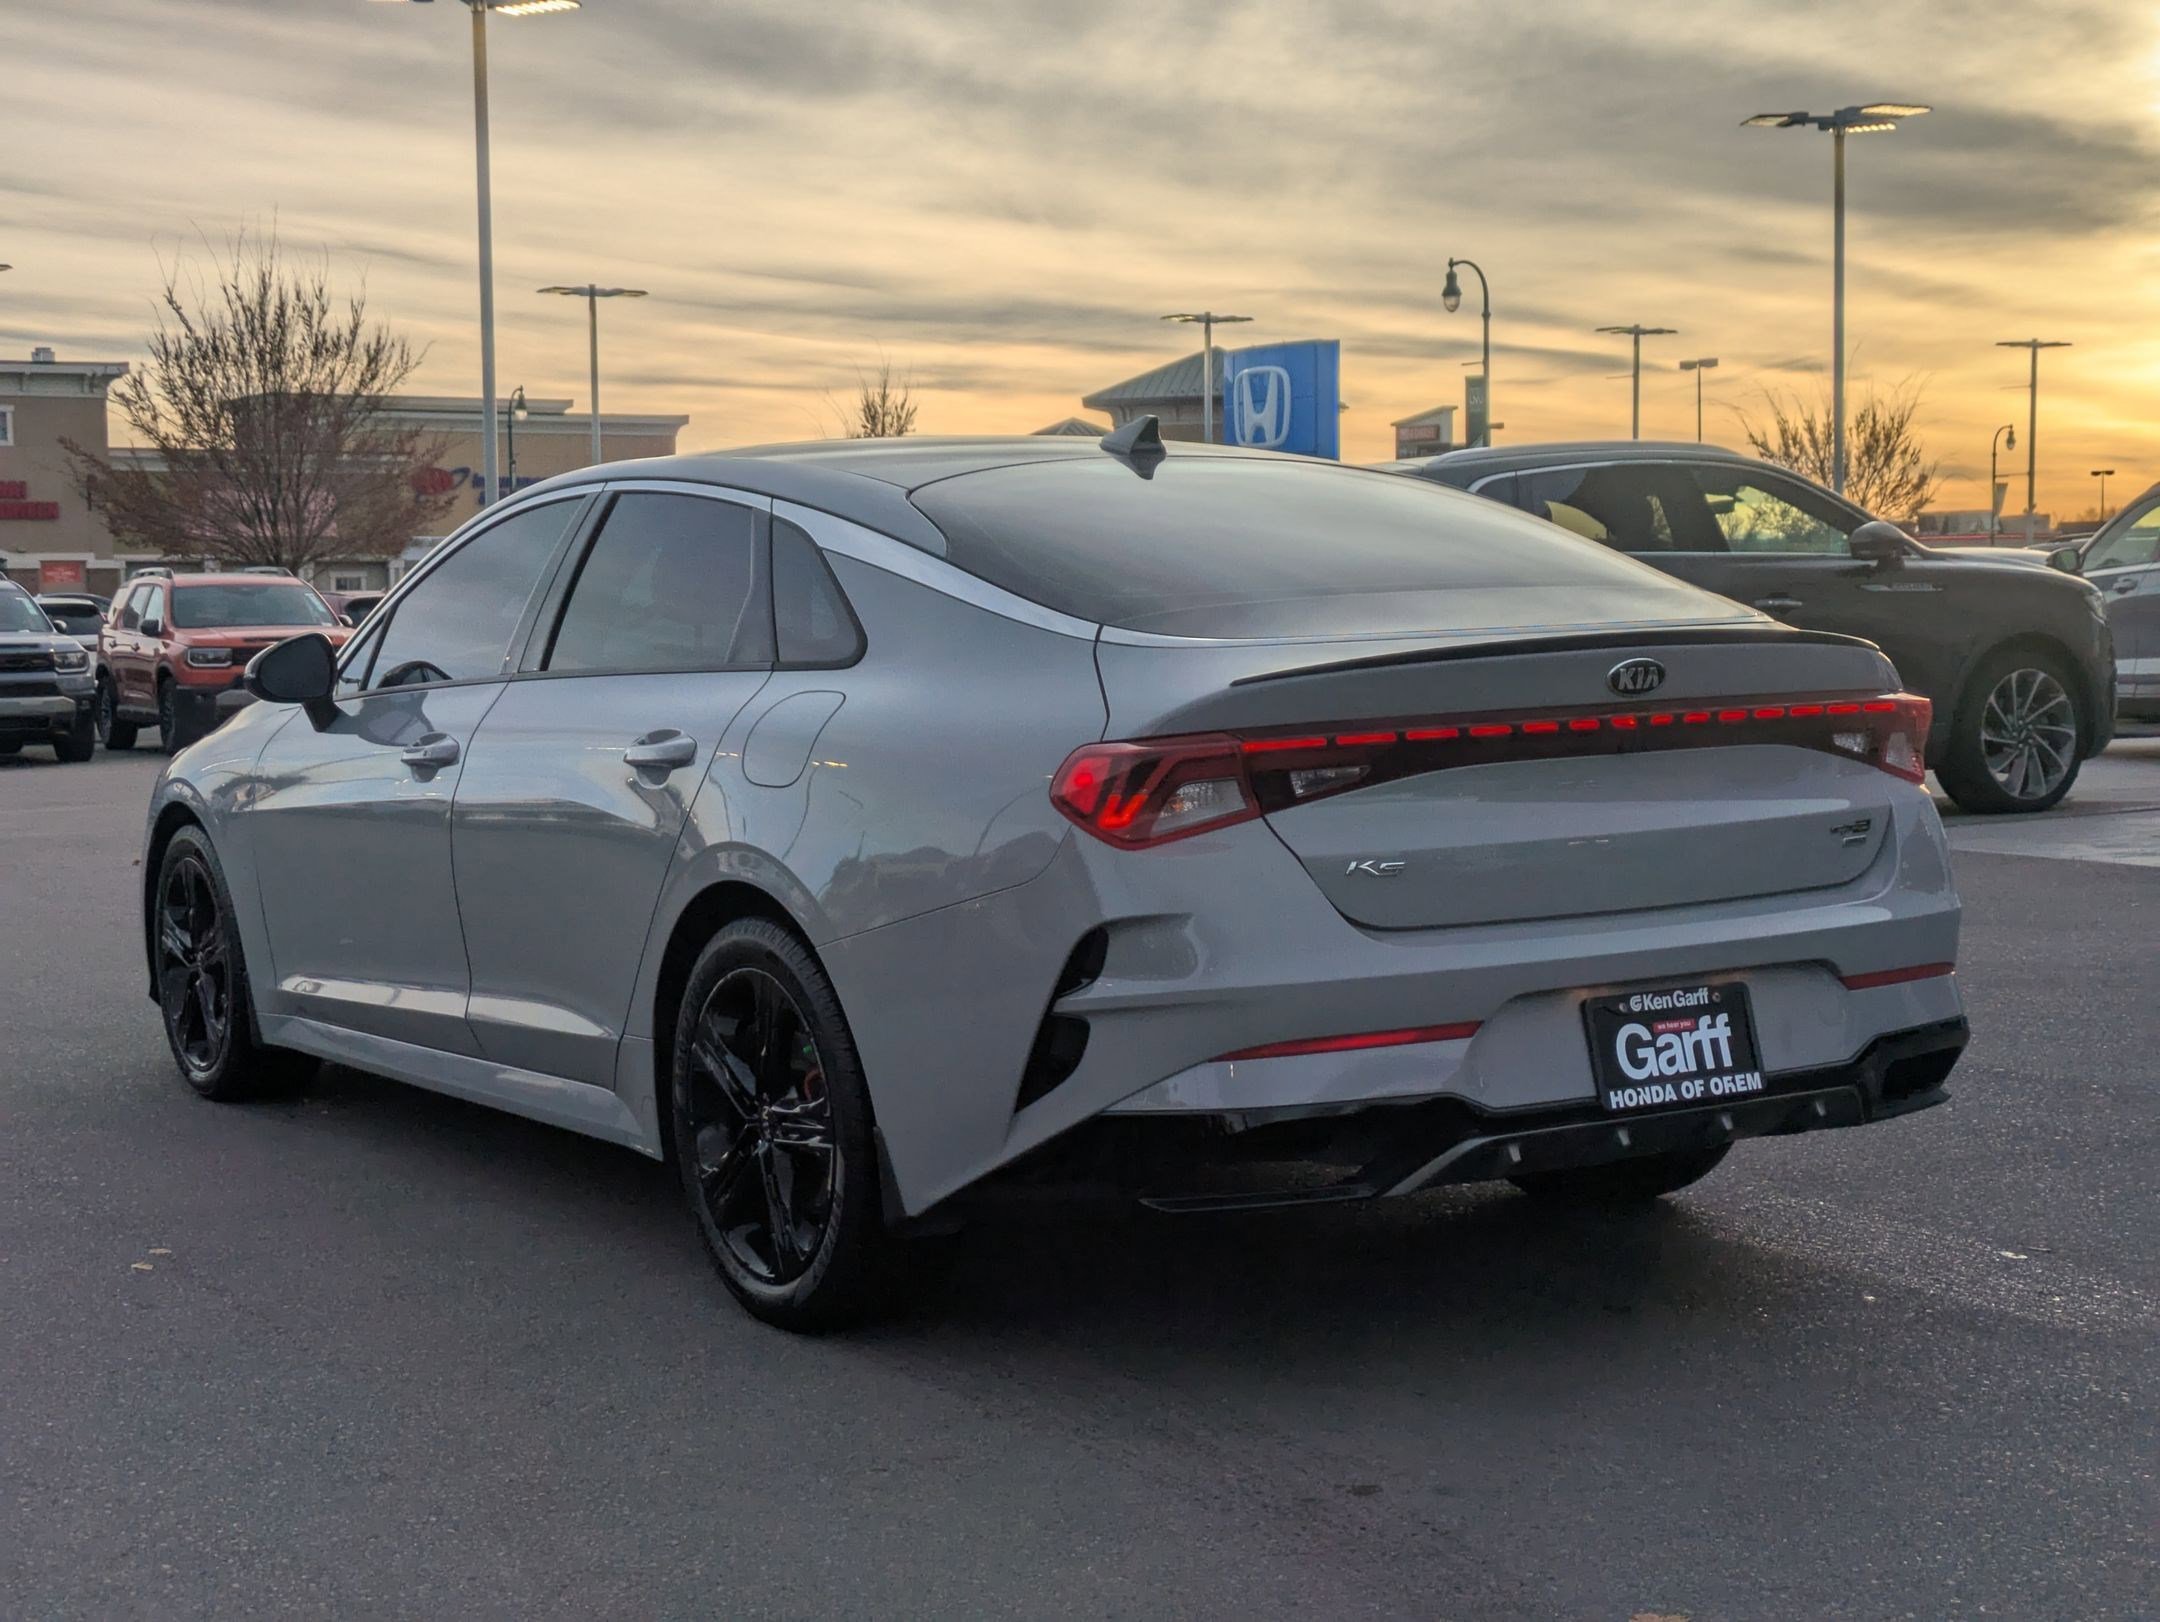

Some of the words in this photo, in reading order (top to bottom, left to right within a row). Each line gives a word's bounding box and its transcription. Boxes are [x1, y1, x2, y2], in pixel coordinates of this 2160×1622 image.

[1618, 667, 1659, 690] KIA
[1616, 1012, 1733, 1080] Garff
[1609, 1083, 1678, 1110] HONDA
[1681, 1079, 1706, 1099] OF
[1709, 1071, 1763, 1097] OREM
